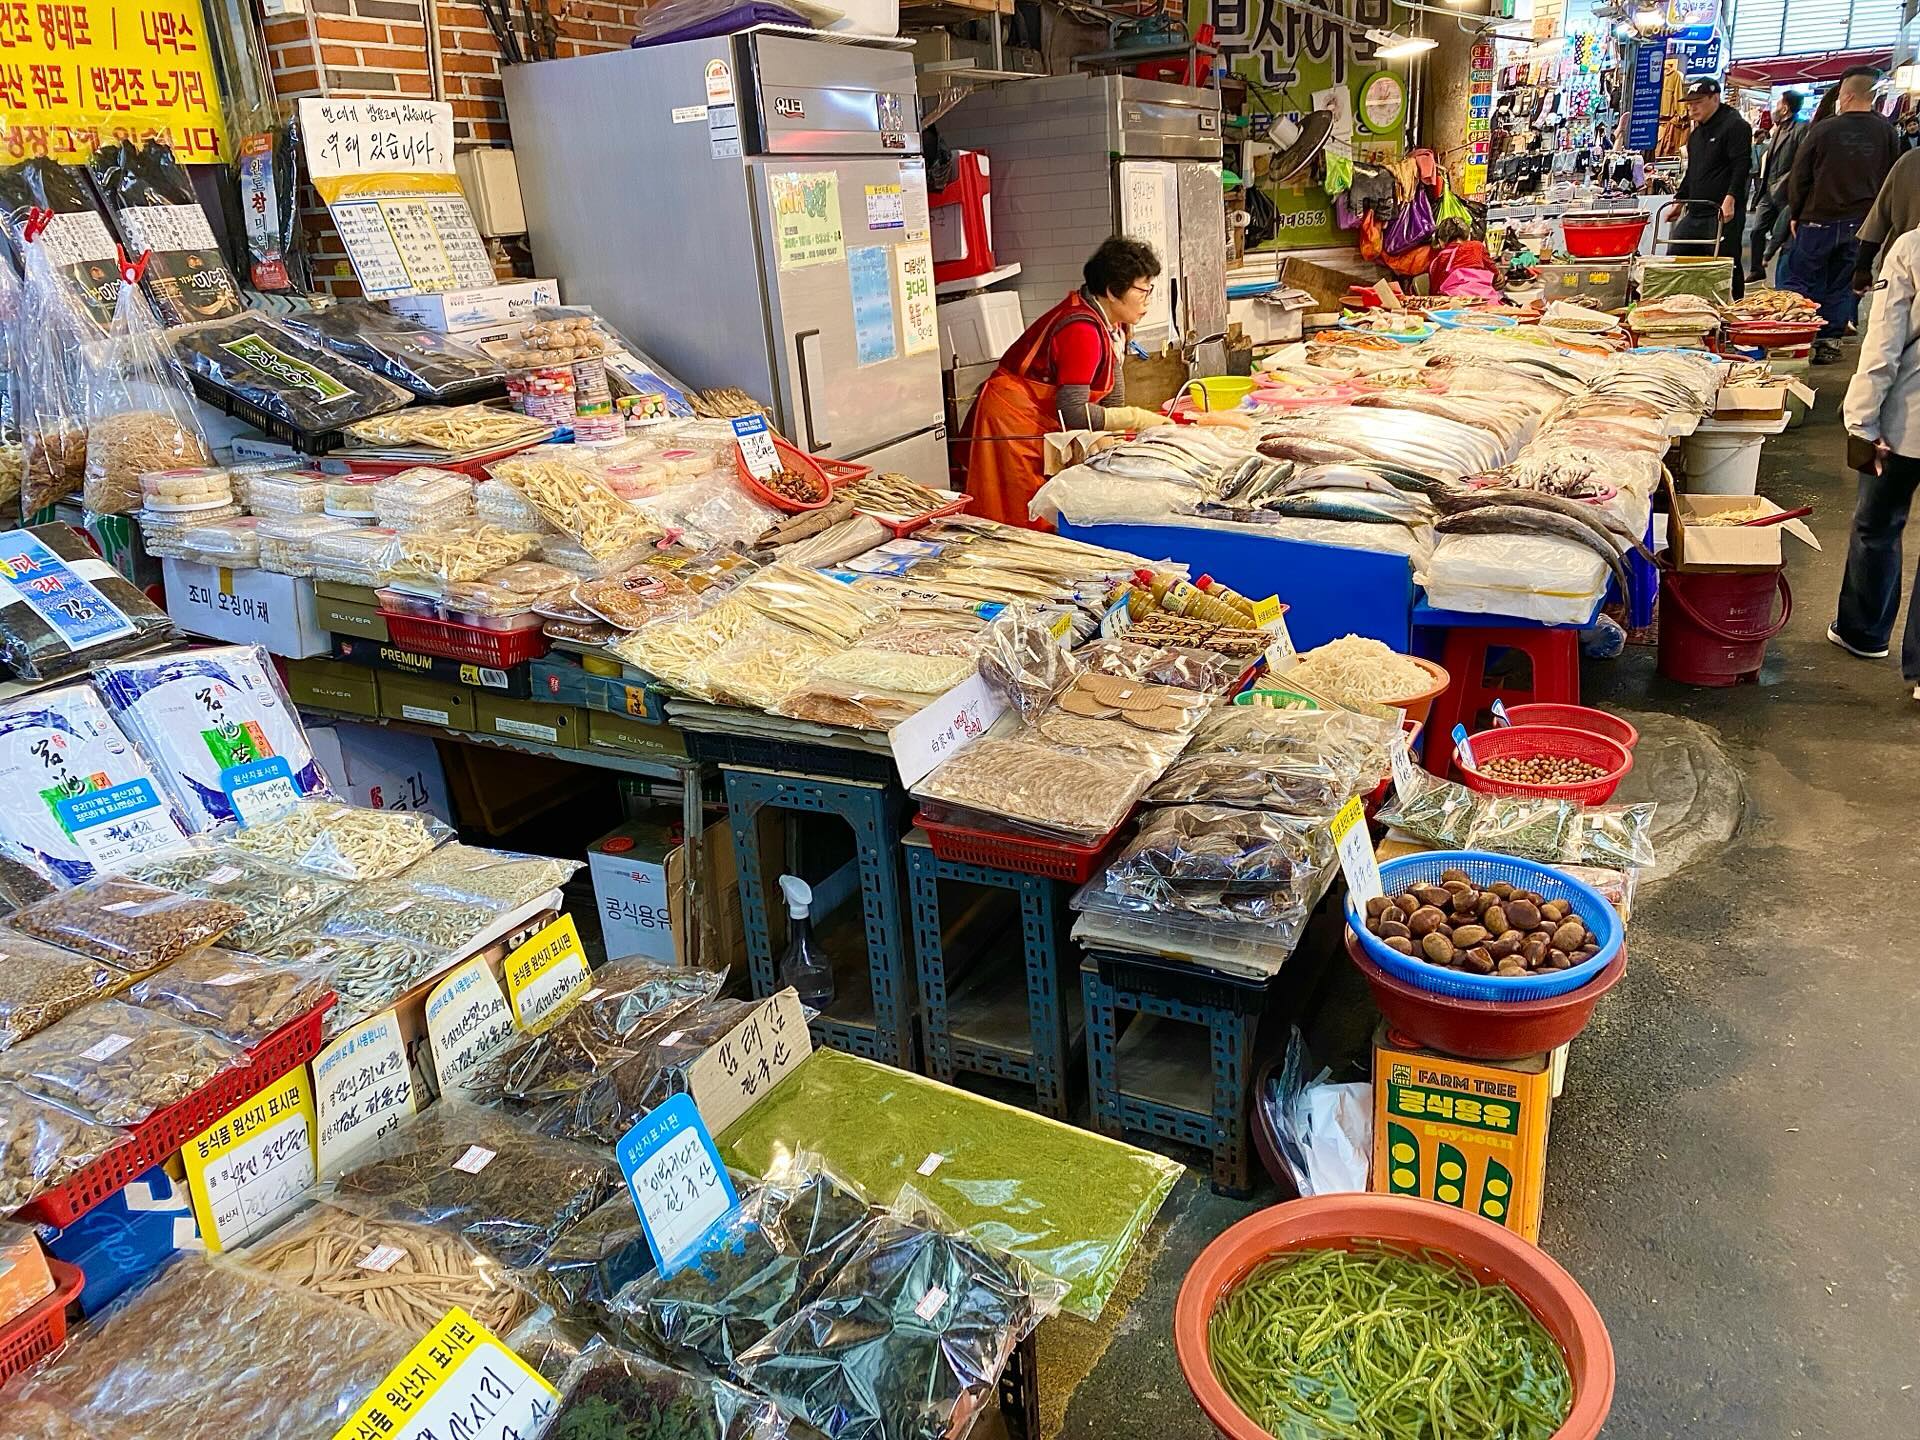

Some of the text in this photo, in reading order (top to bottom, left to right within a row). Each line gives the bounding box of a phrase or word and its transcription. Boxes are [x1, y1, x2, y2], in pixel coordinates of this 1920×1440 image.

[36, 3, 92, 51] 명태포
[140, 10, 197, 56] 나막스
[29, 64, 68, 110] 쥐포
[90, 66, 148, 111] 반건조
[152, 69, 208, 113] 노가리
[370, 132, 435, 166] 있습니다
[188, 584, 270, 625] 조미 오징어채
[380, 647, 432, 670] PREMIUM
[606, 897, 673, 931] 콩식용유
[512, 933, 572, 986] 농식품 원산지 표시판
[1392, 1077, 1411, 1087] TREE
[1393, 1064, 1411, 1074] FARM
[1418, 1070, 1517, 1098] FARM TREE
[197, 1086, 301, 1158] 농식품 원산지 표시판
[1398, 1088, 1511, 1129] 콩식용유
[627, 1112, 681, 1165] 원산지표시판
[217, 1207, 240, 1227] 원산지
[349, 1321, 476, 1440] 식품 원산지 표시판
